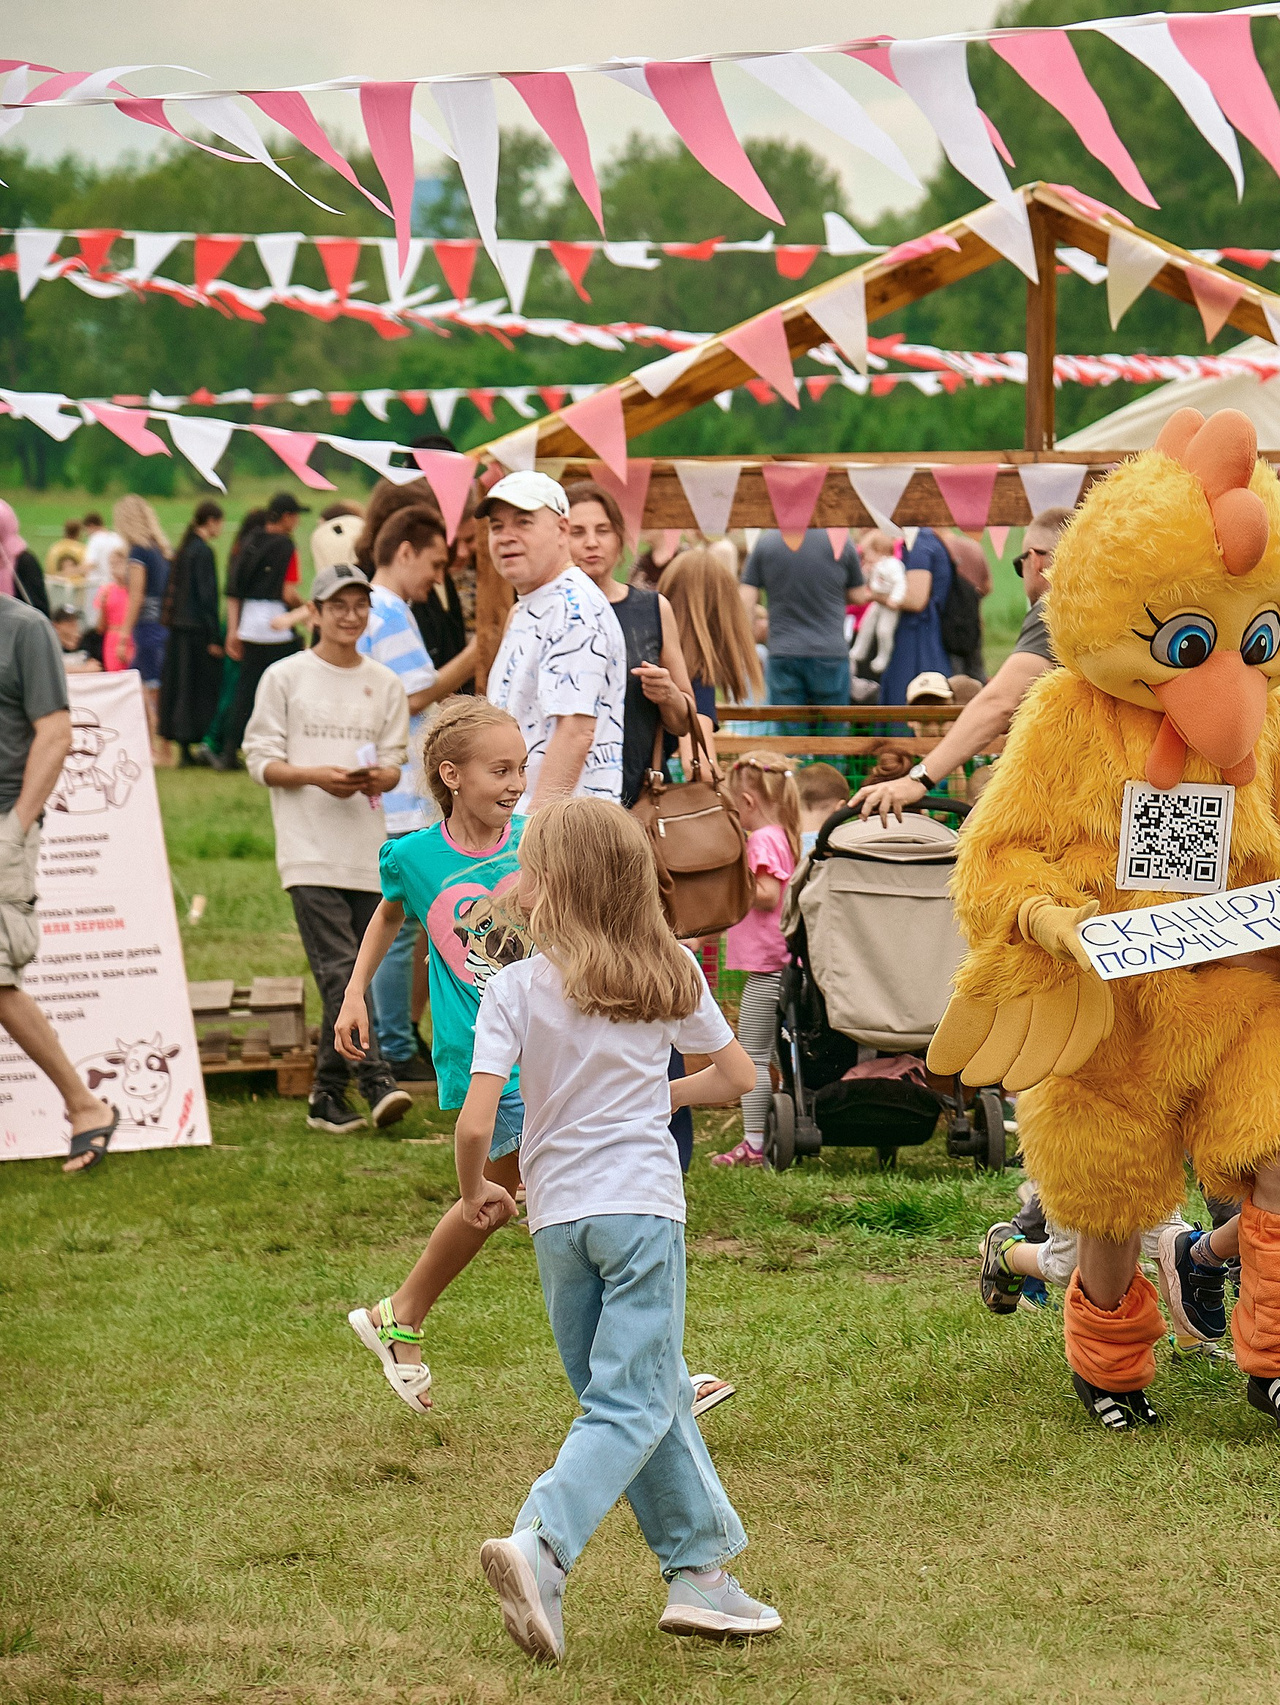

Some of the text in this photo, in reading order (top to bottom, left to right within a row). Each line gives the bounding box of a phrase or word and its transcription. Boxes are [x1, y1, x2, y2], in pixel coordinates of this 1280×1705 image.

[49, 832, 110, 846] животные
[50, 848, 101, 861] местных
[75, 905, 116, 915] можно
[43, 917, 125, 935] ИЛИ ЗЕРНОМ
[42, 953, 82, 964] садите
[85, 953, 100, 961] на
[126, 944, 161, 958] детей
[1096, 928, 1239, 974] ПОЛУЧИ
[42, 971, 89, 985] тянутся
[102, 969, 125, 979] вам
[128, 966, 157, 976] сами
[56, 1008, 85, 1022] едой
